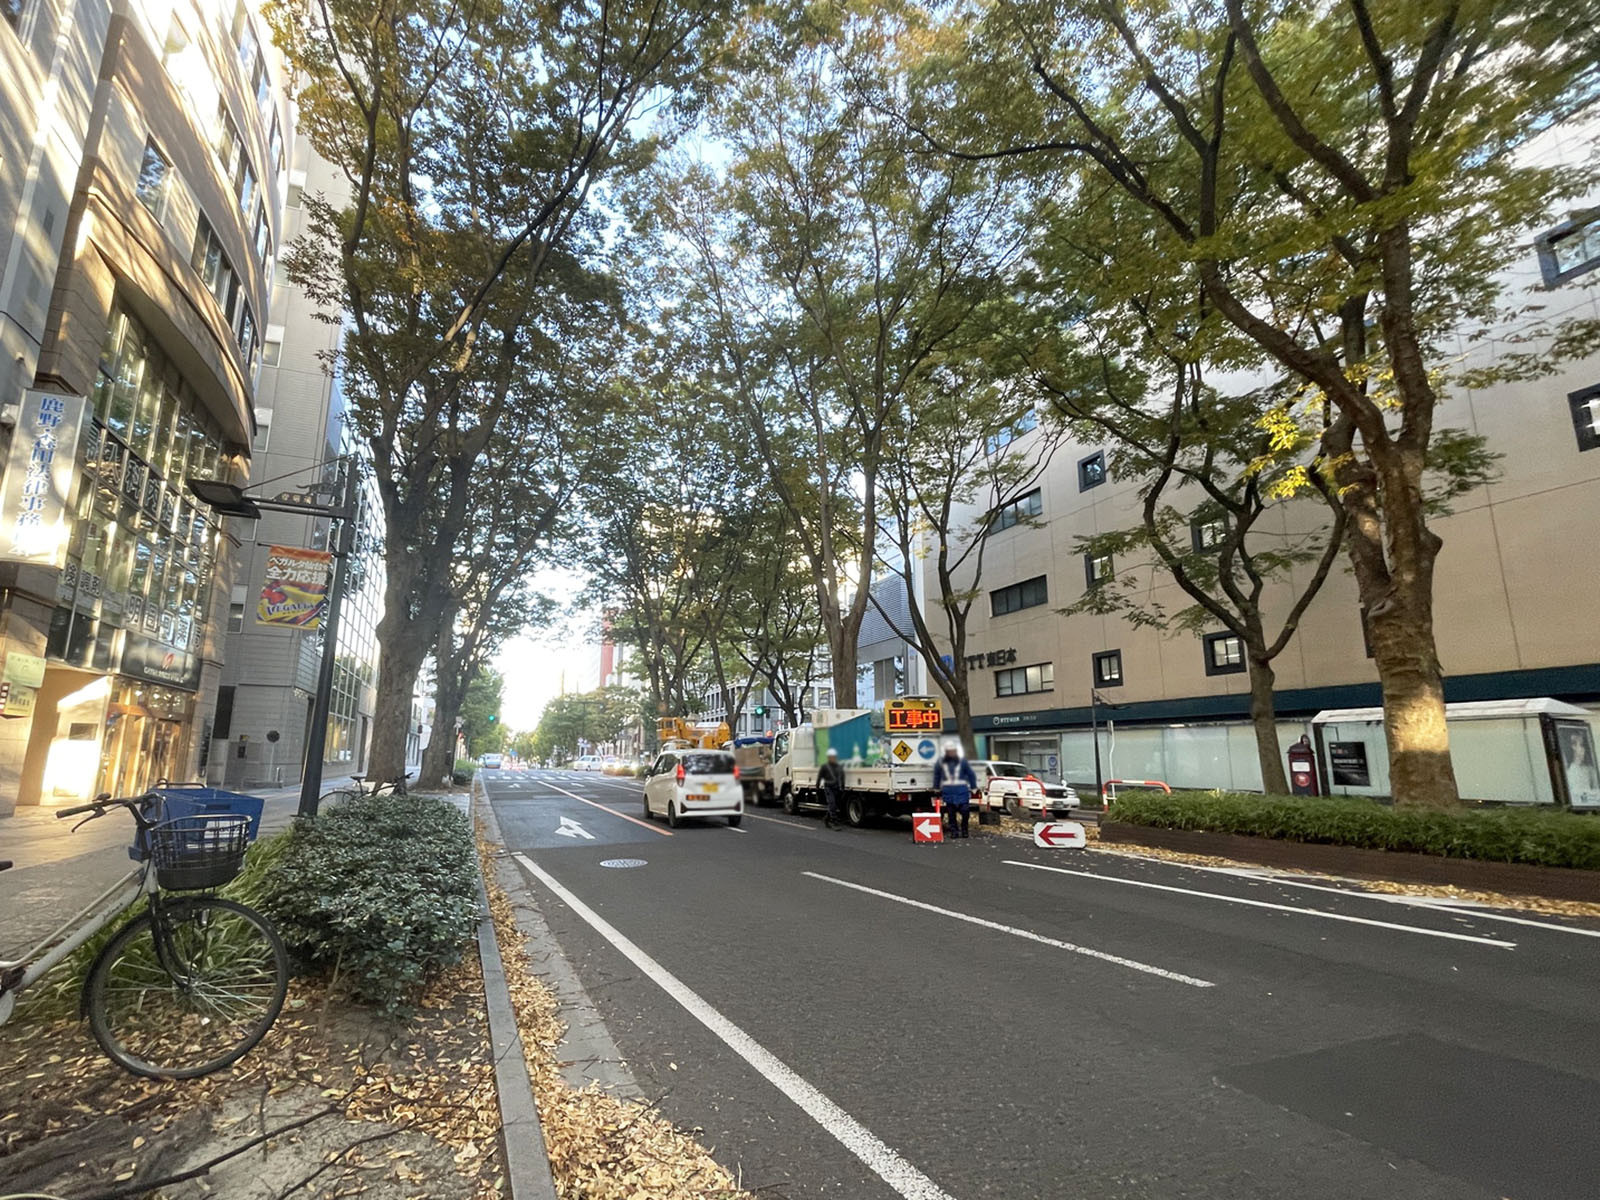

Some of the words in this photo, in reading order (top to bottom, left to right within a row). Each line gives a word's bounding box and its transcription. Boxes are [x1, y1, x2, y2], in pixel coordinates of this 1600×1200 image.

[9, 397, 65, 556] 鹿野・森田法律事務
[266, 566, 327, 585] 全力応援
[890, 709, 939, 729] 工事中
